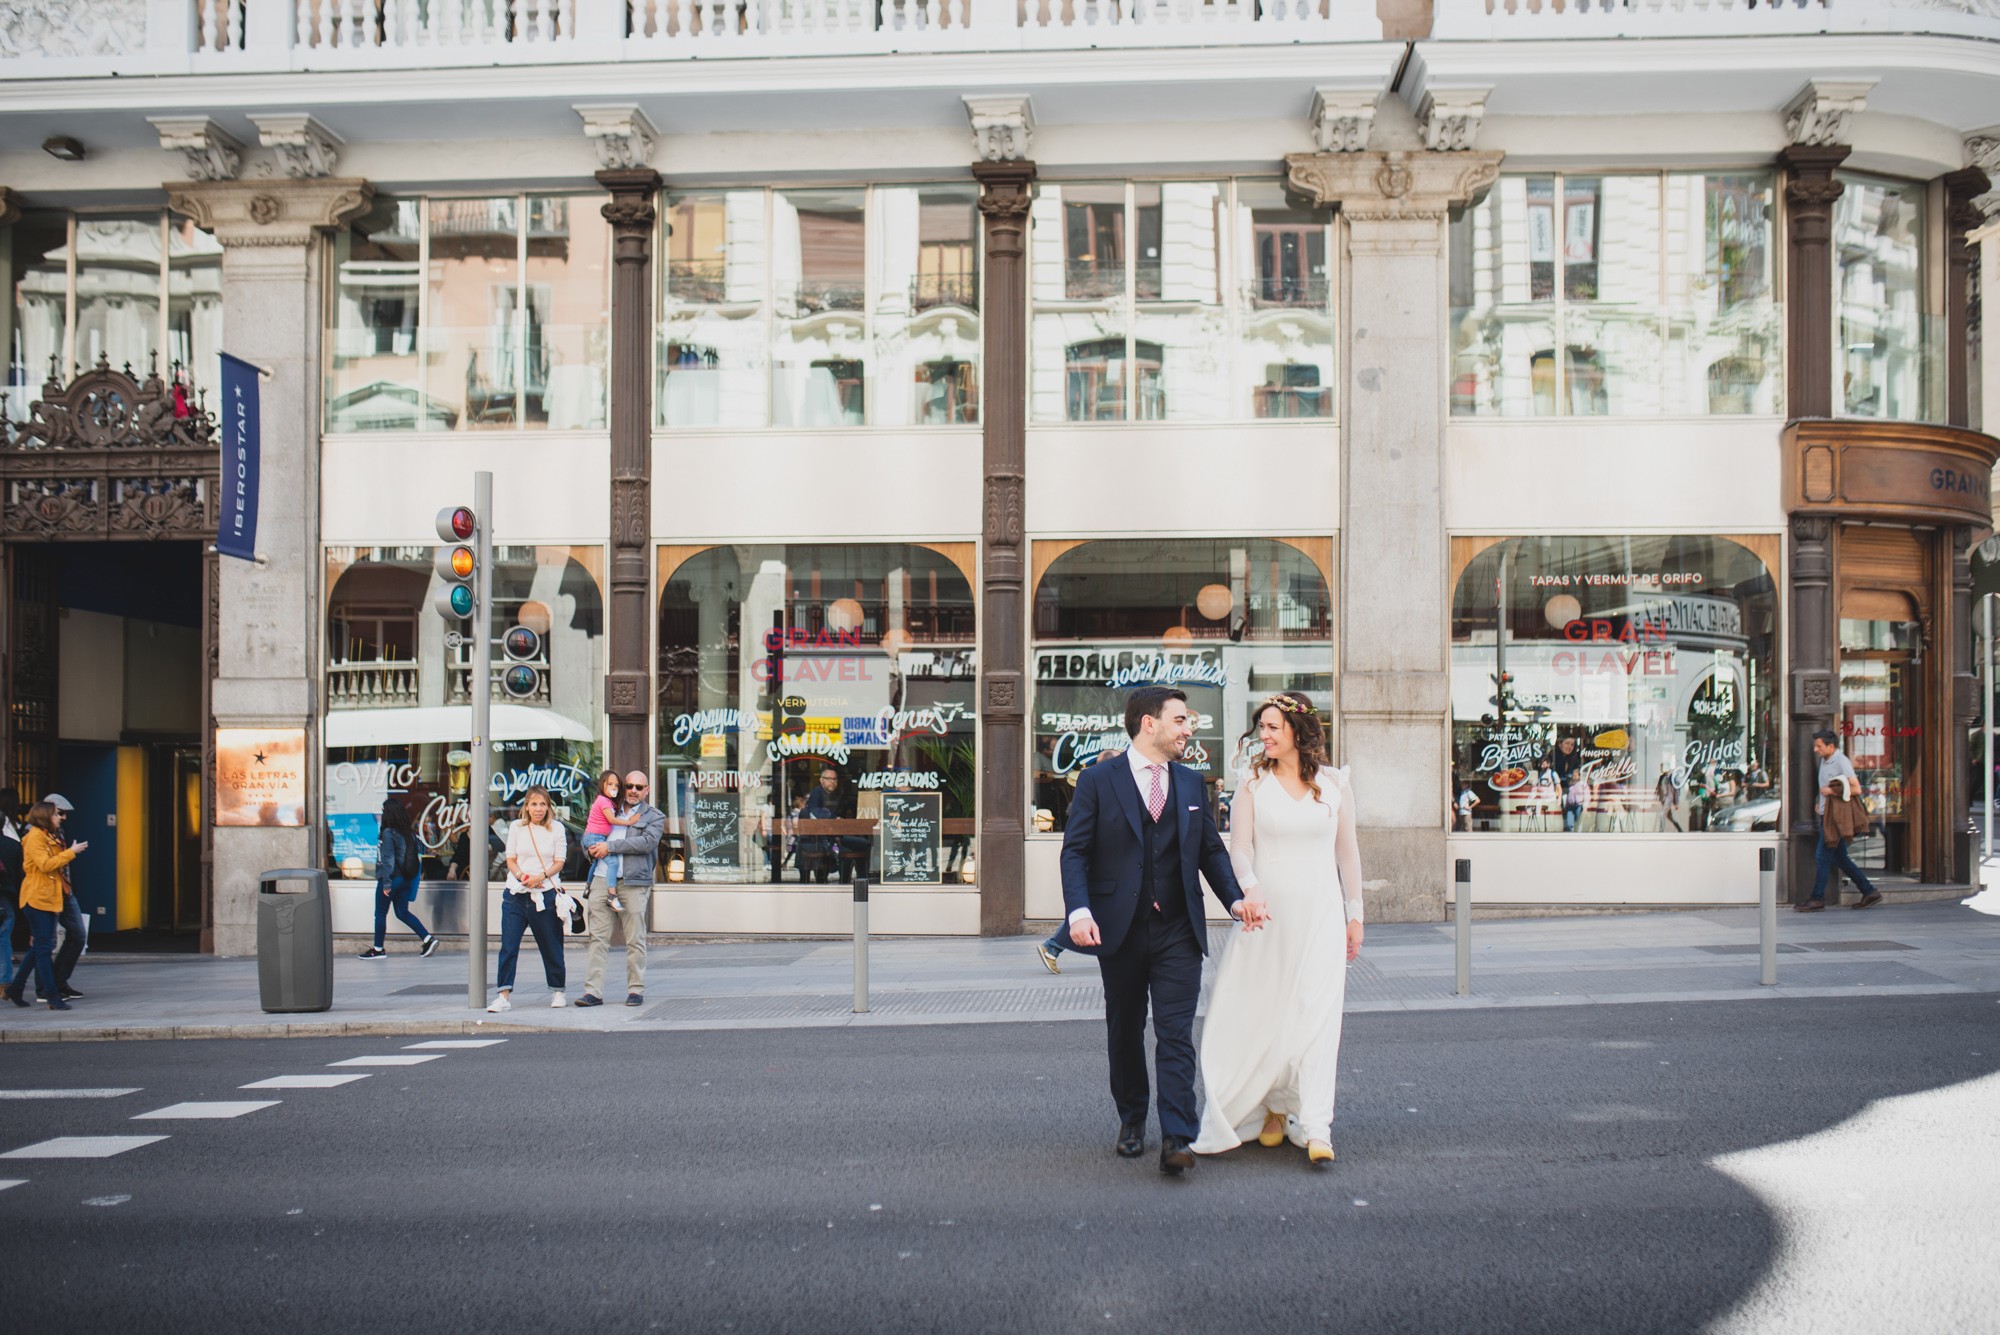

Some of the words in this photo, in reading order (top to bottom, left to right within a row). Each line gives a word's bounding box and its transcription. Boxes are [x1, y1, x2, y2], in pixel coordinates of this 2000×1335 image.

[234, 402, 246, 536] IBEROSTAR
[1529, 575, 1570, 586] TAPAS
[1573, 576, 1582, 585] Y
[1585, 574, 1639, 586] VERMUT
[1642, 573, 1660, 584] DE
[1662, 572, 1704, 584] GRIFO
[763, 626, 862, 650] GRAN
[1564, 619, 1668, 643] GRAN
[751, 657, 873, 682] CLAVEL
[1552, 651, 1679, 676] CLAVEL
[777, 697, 849, 708] VERMUTERÍA
[673, 708, 760, 746] Desayunos
[875, 705, 948, 743] Cenas
[1489, 732, 1523, 741] PATATAS
[766, 732, 851, 766] COMIDAS
[223, 771, 246, 780] LAS
[251, 771, 297, 780] LETRAS
[336, 757, 421, 795] Vino
[1580, 756, 1638, 786] Tortilla
[1671, 739, 1743, 789] Gildas
[492, 758, 590, 801] Vermut
[688, 771, 762, 788] APERITIVOS
[419, 795, 471, 848] Cañ
